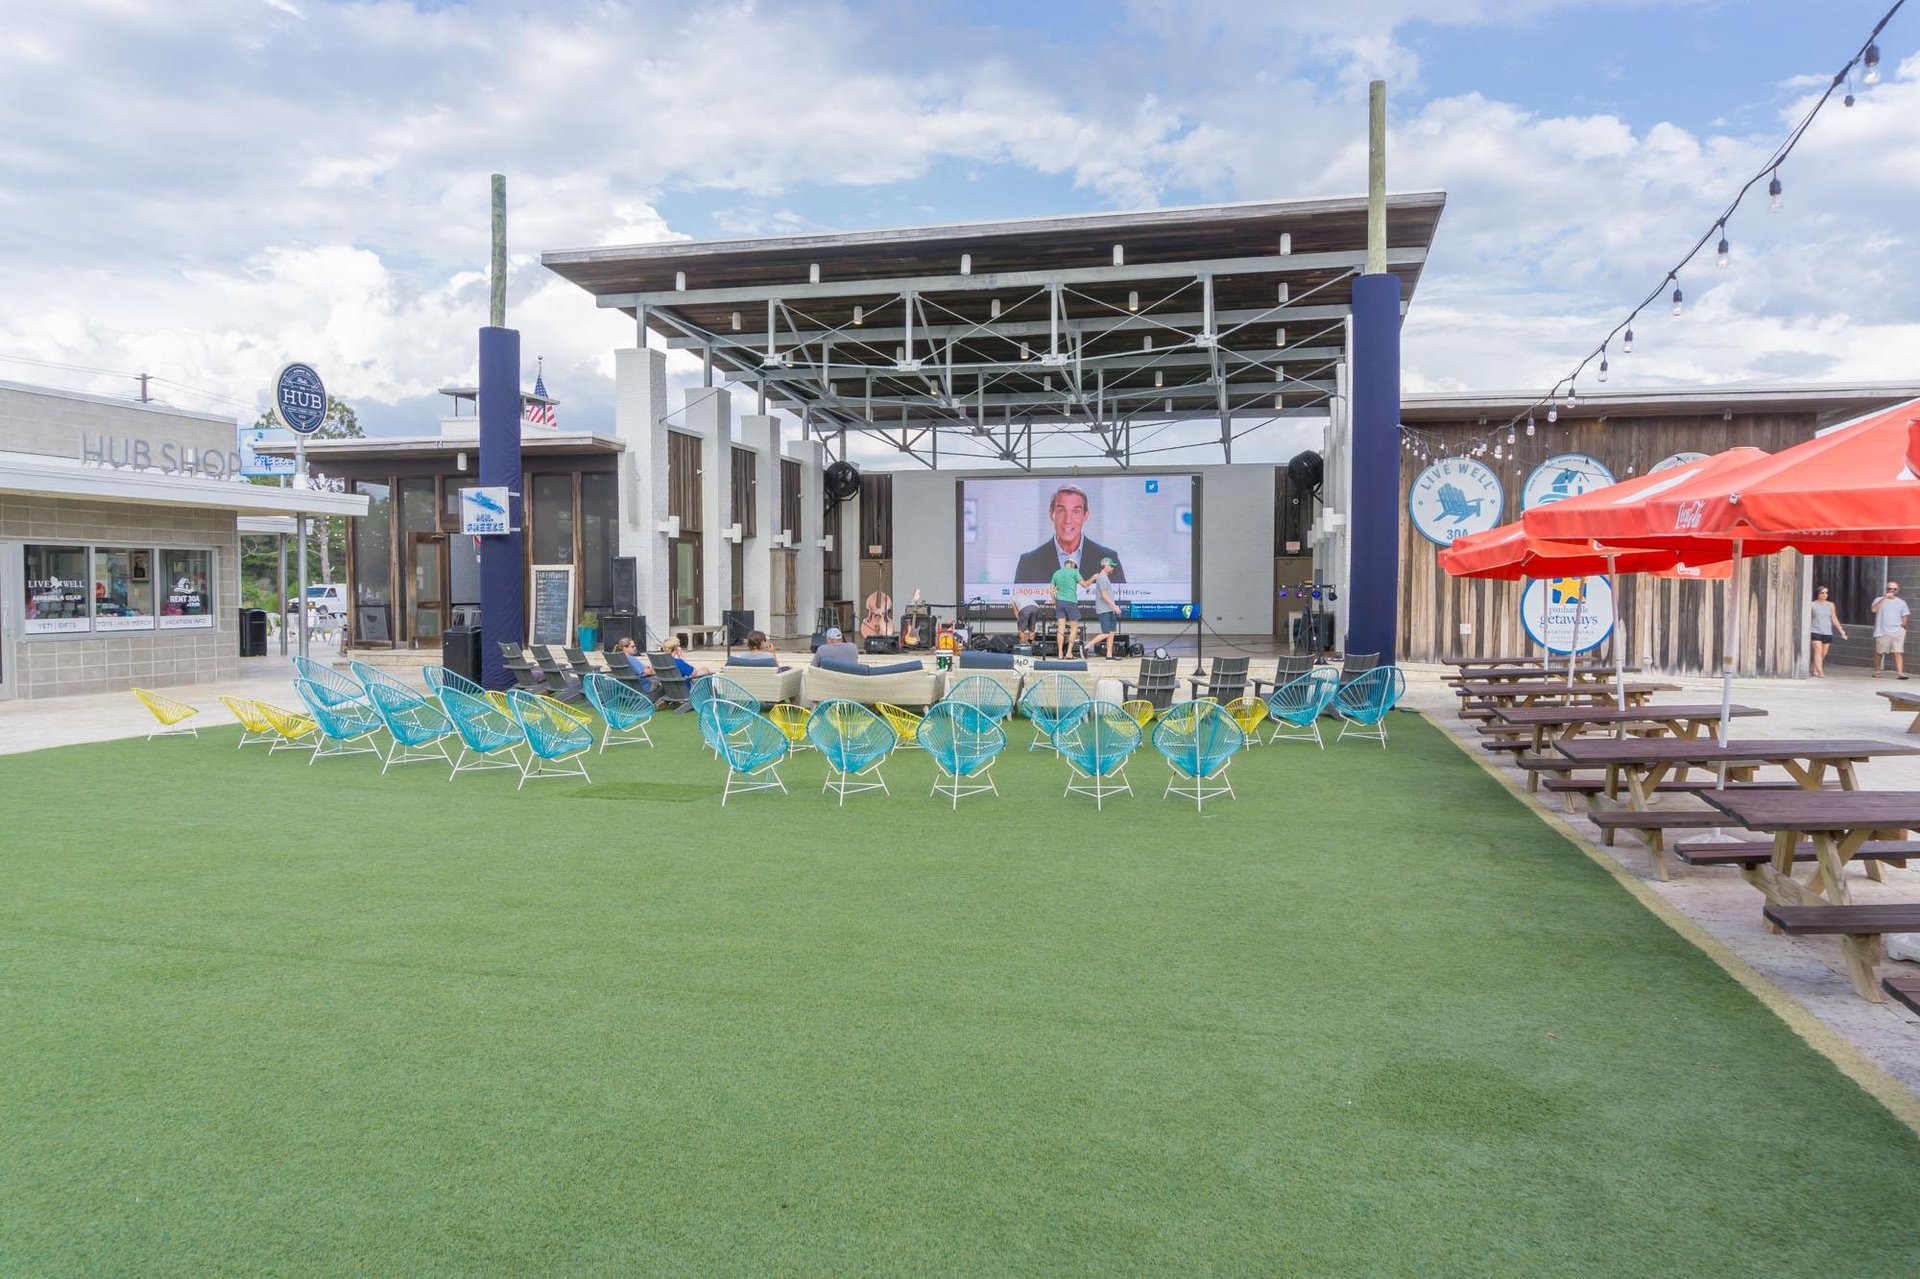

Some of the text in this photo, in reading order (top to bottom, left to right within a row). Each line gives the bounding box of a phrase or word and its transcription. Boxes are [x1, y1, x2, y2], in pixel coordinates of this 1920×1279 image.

[282, 388, 322, 409] HUB
[80, 432, 243, 481] HUB SHOP
[1420, 463, 1493, 490] LIVE WELL
[467, 523, 504, 532] FREEZE
[28, 580, 84, 588] LIVE WELL
[169, 595, 200, 603] RENT 30A
